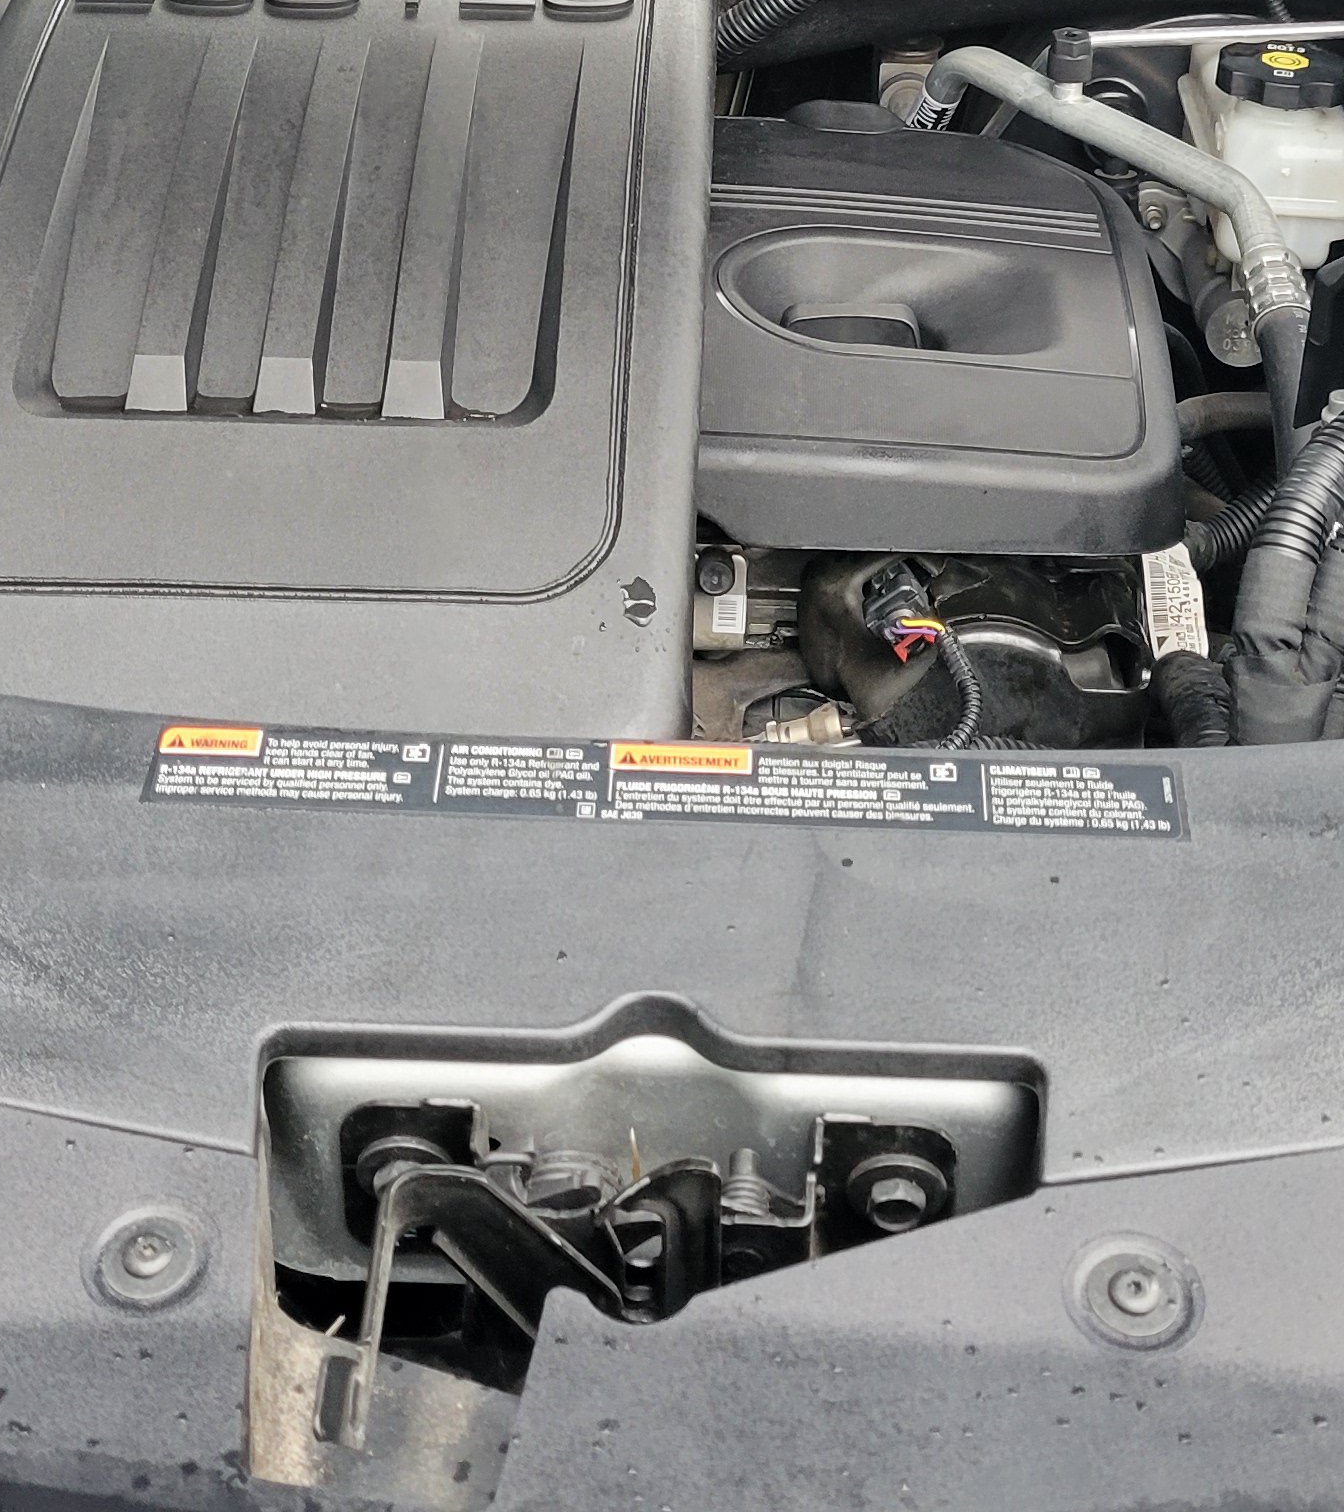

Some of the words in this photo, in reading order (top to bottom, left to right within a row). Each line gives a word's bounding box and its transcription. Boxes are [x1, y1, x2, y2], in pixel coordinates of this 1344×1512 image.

[191, 737, 249, 749] WARNING
[268, 737, 279, 748] To
[281, 737, 301, 749] help
[303, 739, 328, 749] avoid
[330, 741, 370, 752] personal
[265, 747, 289, 758] keep
[291, 748, 319, 757] hands
[321, 748, 344, 758] clear
[346, 749, 356, 758] of
[451, 744, 469, 756] AIR
[471, 746, 543, 757] CONDITIONING
[272, 757, 289, 766] can
[291, 758, 314, 767] start
[315, 758, 325, 767] at
[327, 759, 345, 769] any
[449, 756, 467, 766] Use
[469, 757, 490, 768] only
[491, 758, 526, 768] R-134a
[528, 759, 580, 770] Refrigerant
[582, 762, 600, 772] and
[640, 755, 739, 768] AVERTISSEMENT
[758, 756, 800, 767] Attention
[802, 759, 820, 768] aux
[855, 760, 887, 771] Risque
[160, 764, 196, 776] R-134a
[198, 765, 268, 778] REFRIGERANT
[270, 768, 306, 779] UNDER
[306, 769, 332, 780] HIGH
[333, 770, 387, 782] PRESSURE
[448, 766, 506, 777] Polyalkylene
[508, 767, 536, 779] Glycol
[538, 769, 550, 778] oil
[758, 766, 770, 775] de
[773, 767, 820, 777] blessures.
[822, 768, 834, 777] Le
[836, 769, 885, 779] ventilateur
[887, 771, 908, 780] peut
[910, 772, 922, 780] se
[989, 765, 1057, 778] CLIMATISEUR
[158, 774, 193, 785] System
[195, 775, 205, 784] to
[206, 775, 219, 785] be
[221, 776, 261, 787] serviced
[262, 778, 275, 788] by
[276, 778, 317, 789] qualified
[319, 780, 365, 791] personnel
[448, 775, 465, 786] The
[467, 776, 501, 787] system
[502, 778, 542, 788] contains
[544, 779, 564, 789] dye.
[758, 776, 789, 785] mettre
[800, 777, 834, 786] tourner
[836, 779, 858, 787] sans
[860, 779, 929, 790] avertissement.
[990, 777, 1023, 787] Utiliser
[1025, 778, 1074, 789] seulement
[1076, 780, 1085, 789] le
[1087, 780, 1114, 790] fluide
[156, 783, 198, 796] Improper
[200, 785, 234, 796] service
[236, 787, 277, 798] methods
[279, 788, 300, 800] may
[302, 790, 330, 799] cause
[332, 791, 373, 801] personal
[445, 785, 481, 796] System
[482, 787, 518, 799] charge:
[520, 788, 542, 798] 0.65
[544, 789, 556, 801] kg
[558, 789, 583, 800] (1.43
[585, 790, 597, 801] lb)
[616, 781, 652, 792] FLUIDE
[723, 784, 759, 795] R-134a
[761, 787, 789, 797] SOUS
[791, 788, 824, 798] HAUTE
[826, 789, 877, 800] PRESSION
[991, 786, 1041, 798] frigorigène
[1044, 788, 1080, 798] R-134a
[1081, 789, 1091, 798] et
[1093, 790, 1105, 799] de
[667, 792, 679, 802] du
[681, 793, 721, 805] système
[723, 794, 741, 804] doit
[764, 796, 803, 807] effectué
[805, 799, 820, 809] par
[822, 799, 835, 808] un
[837, 800, 884, 810] personnel
[886, 801, 920, 811] qualifié
[922, 802, 975, 813] seulement.
[992, 797, 1004, 806] au
[1093, 799, 1120, 809] (huile
[601, 809, 619, 819] SAE
[615, 800, 633, 810] Des
[636, 801, 682, 812] méthodes
[737, 805, 790, 816] incorrectes
[791, 808, 830, 818] peuvent
[831, 809, 863, 819] causer
[865, 810, 883, 820] des
[992, 805, 1004, 815] Le
[1007, 806, 1046, 817] système
[1048, 807, 1087, 817] contient
[1089, 808, 1101, 818] du
[993, 815, 1027, 827] Charge
[1029, 816, 1042, 826] du
[1044, 818, 1085, 829] système
[1116, 820, 1129, 832] kg
[1158, 820, 1171, 832] lb)
